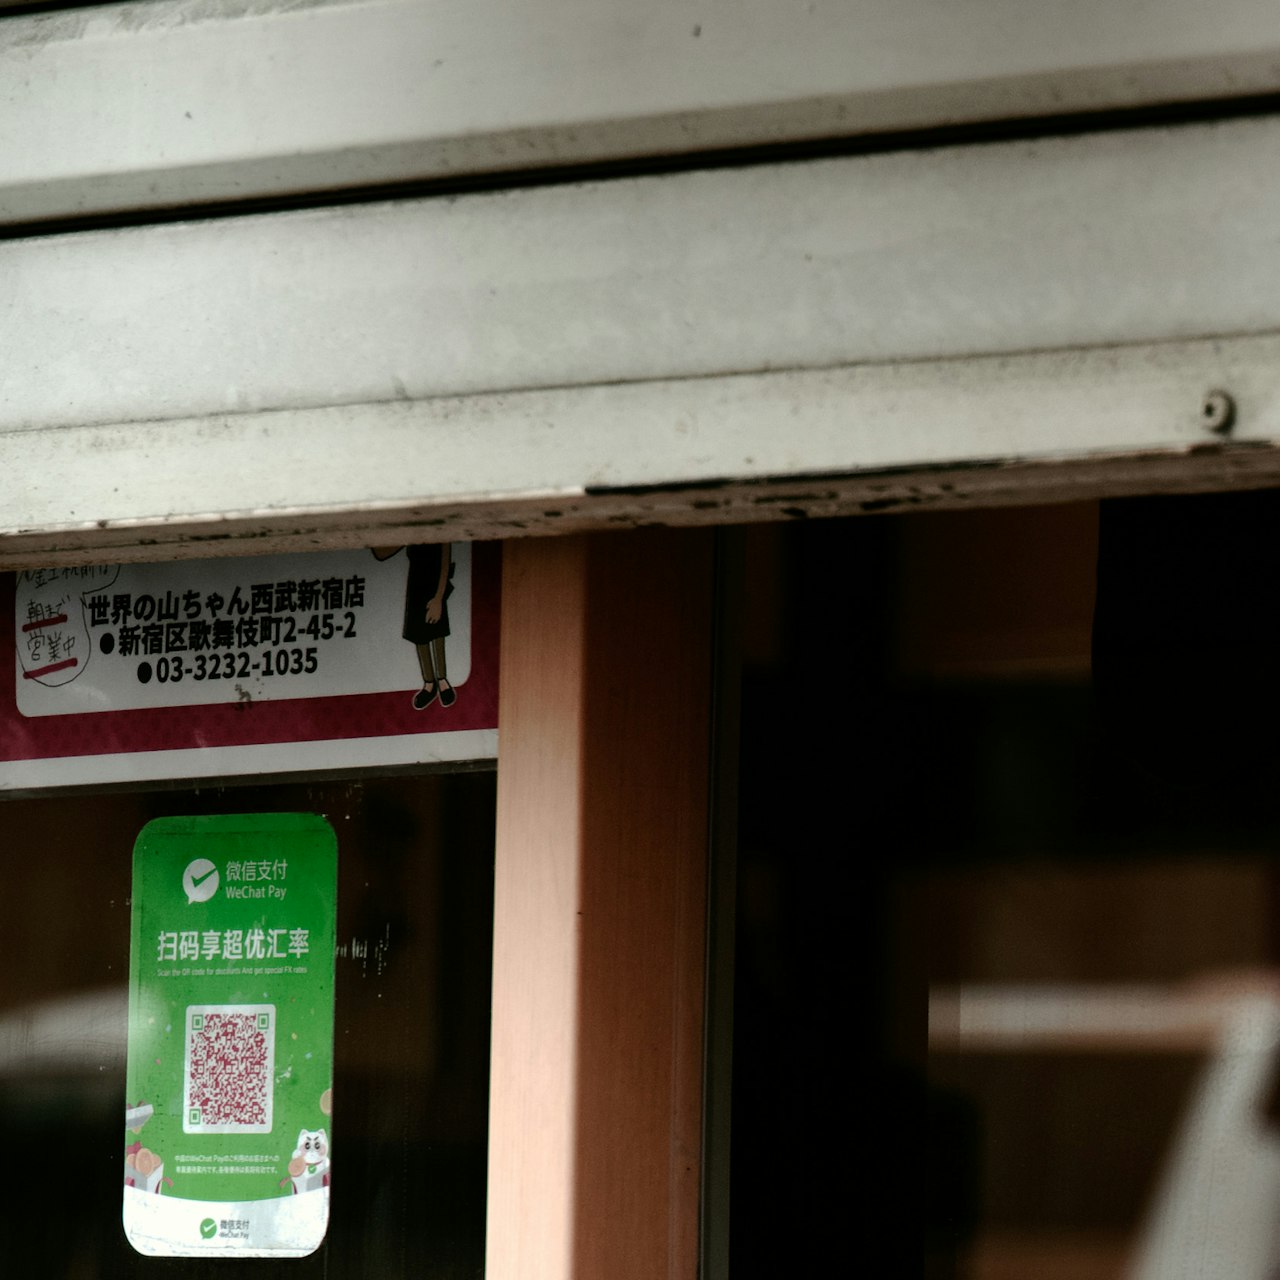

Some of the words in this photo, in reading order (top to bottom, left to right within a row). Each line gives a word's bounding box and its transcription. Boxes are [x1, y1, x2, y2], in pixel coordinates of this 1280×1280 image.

[88, 575, 366, 627] 世界の山ちゃん西武新宿店
[225, 858, 288, 882] 微信支付
[225, 885, 266, 899] WeChat
[267, 885, 287, 901] Pay
[157, 926, 310, 963] 扫码享超优汇率
